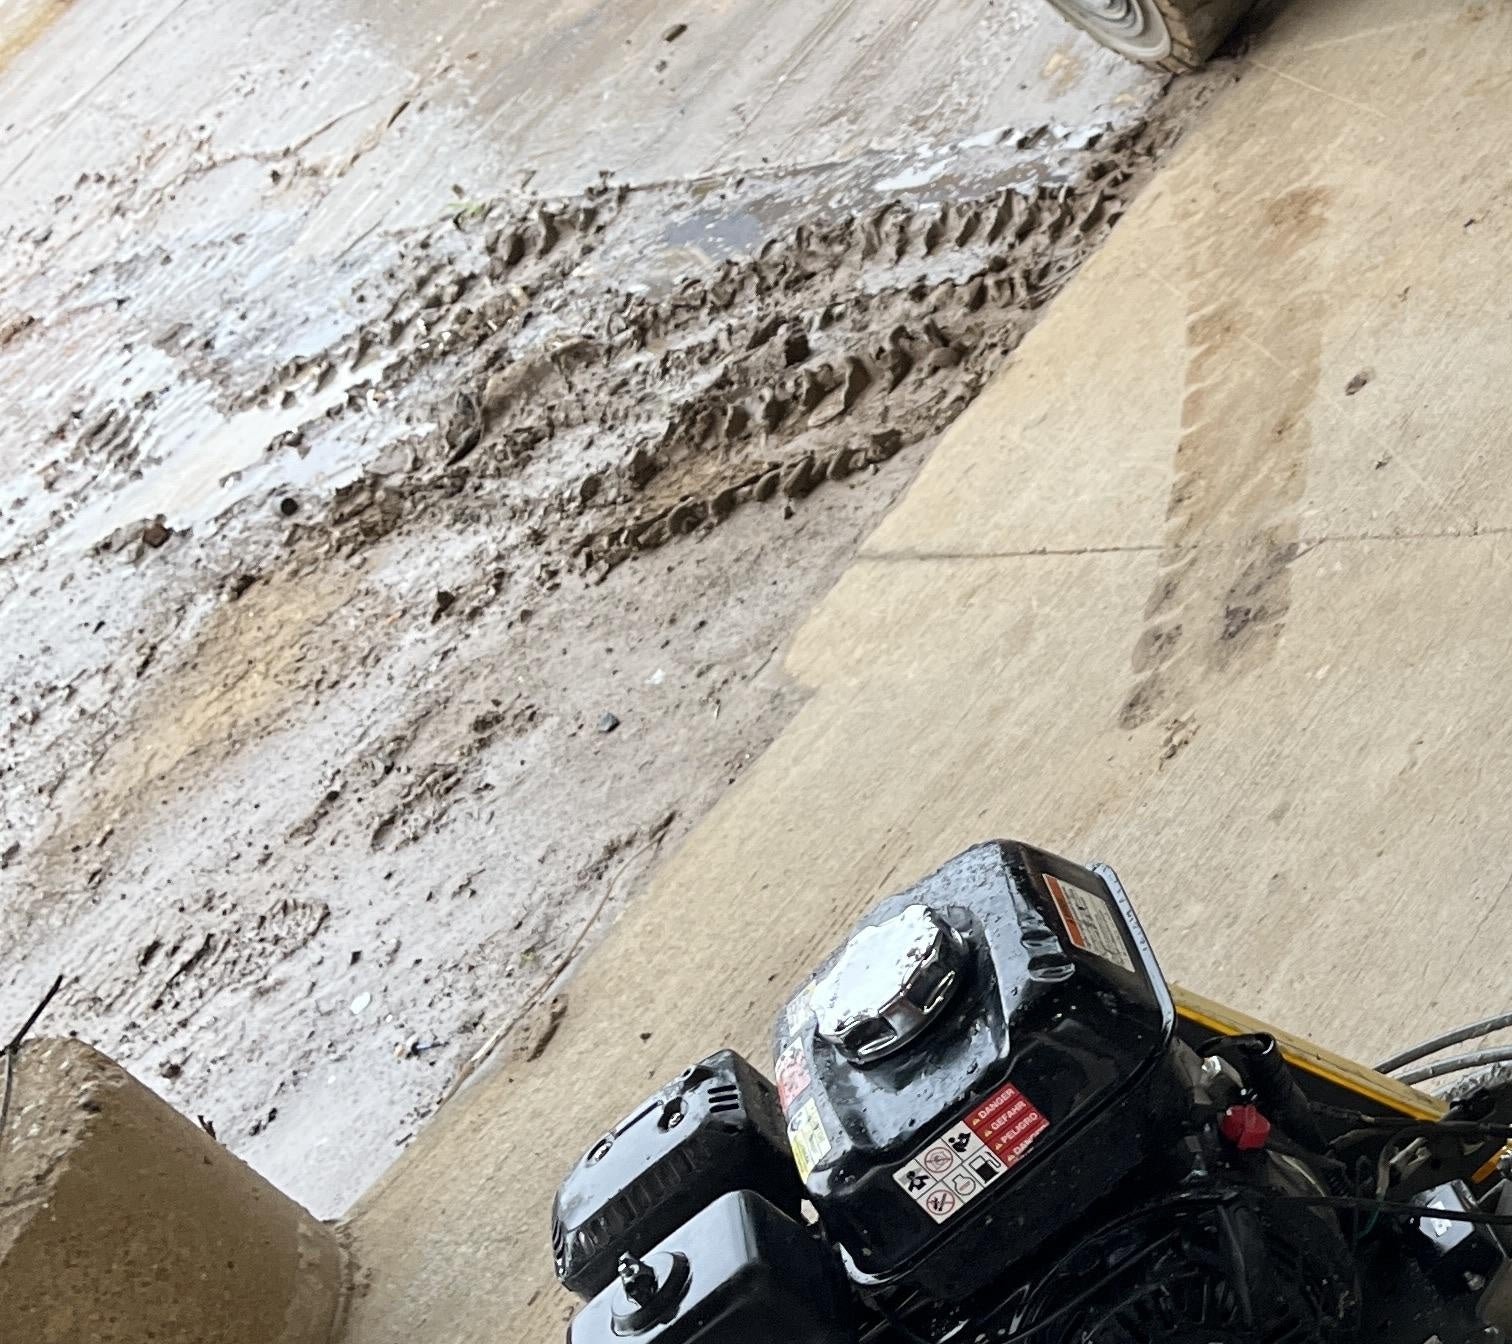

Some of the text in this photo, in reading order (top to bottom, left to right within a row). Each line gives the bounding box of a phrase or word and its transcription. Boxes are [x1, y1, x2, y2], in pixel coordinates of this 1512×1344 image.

[978, 1088, 1015, 1119] DANGER
[991, 1101, 1027, 1130] GEFAHR
[1001, 1113, 1038, 1144] PELIGRO
